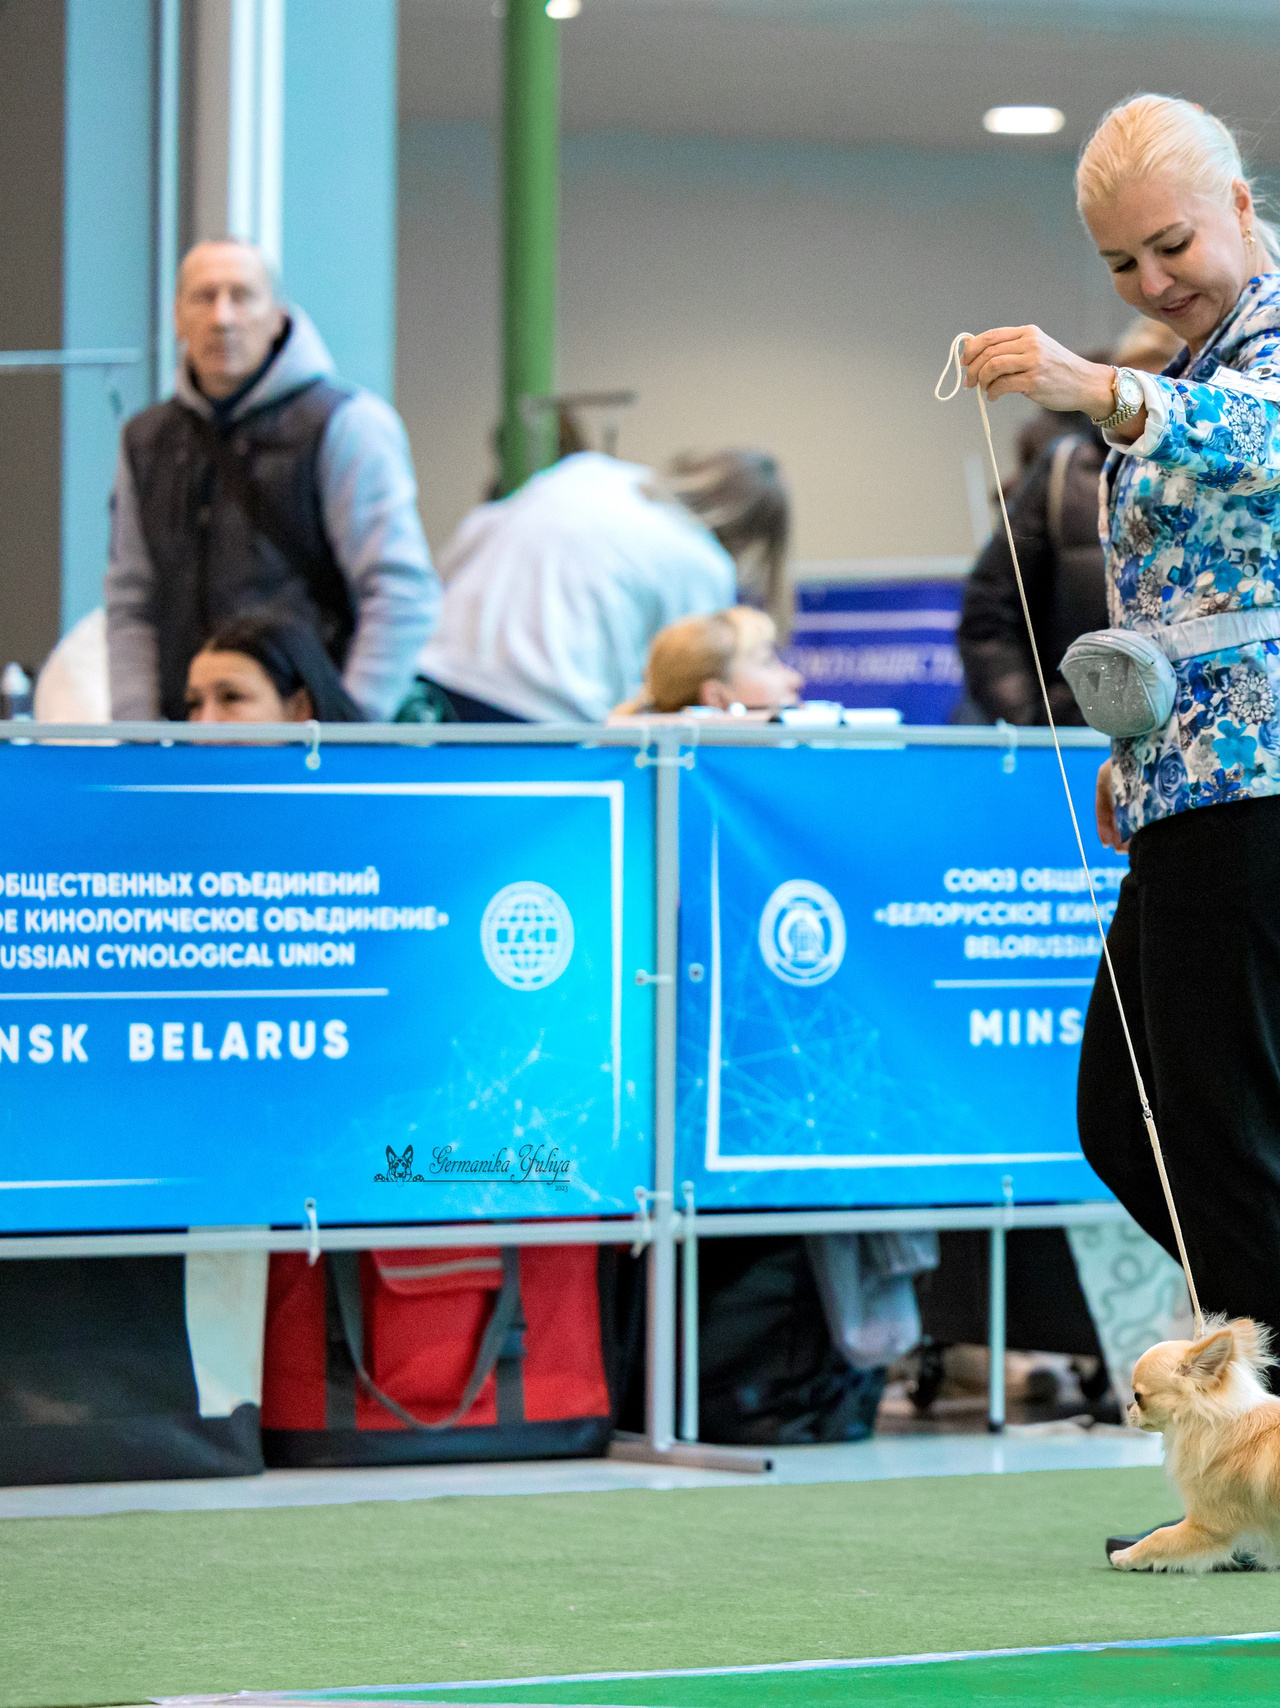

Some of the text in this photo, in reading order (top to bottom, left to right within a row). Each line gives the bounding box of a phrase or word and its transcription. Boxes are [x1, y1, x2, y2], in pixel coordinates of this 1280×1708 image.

[0, 866, 380, 900] БЩЕСТВЕННЫХ ОБЪЕДИНЕНИЙ
[25, 907, 259, 933] КИНОЛОГИЧЕСКОЕ
[263, 906, 449, 934] ОБЪЕДИНЕНИЕ»
[96, 943, 273, 969] CYNOLOGICAL
[278, 942, 355, 967] UNION
[129, 1019, 349, 1062] BELARUS
